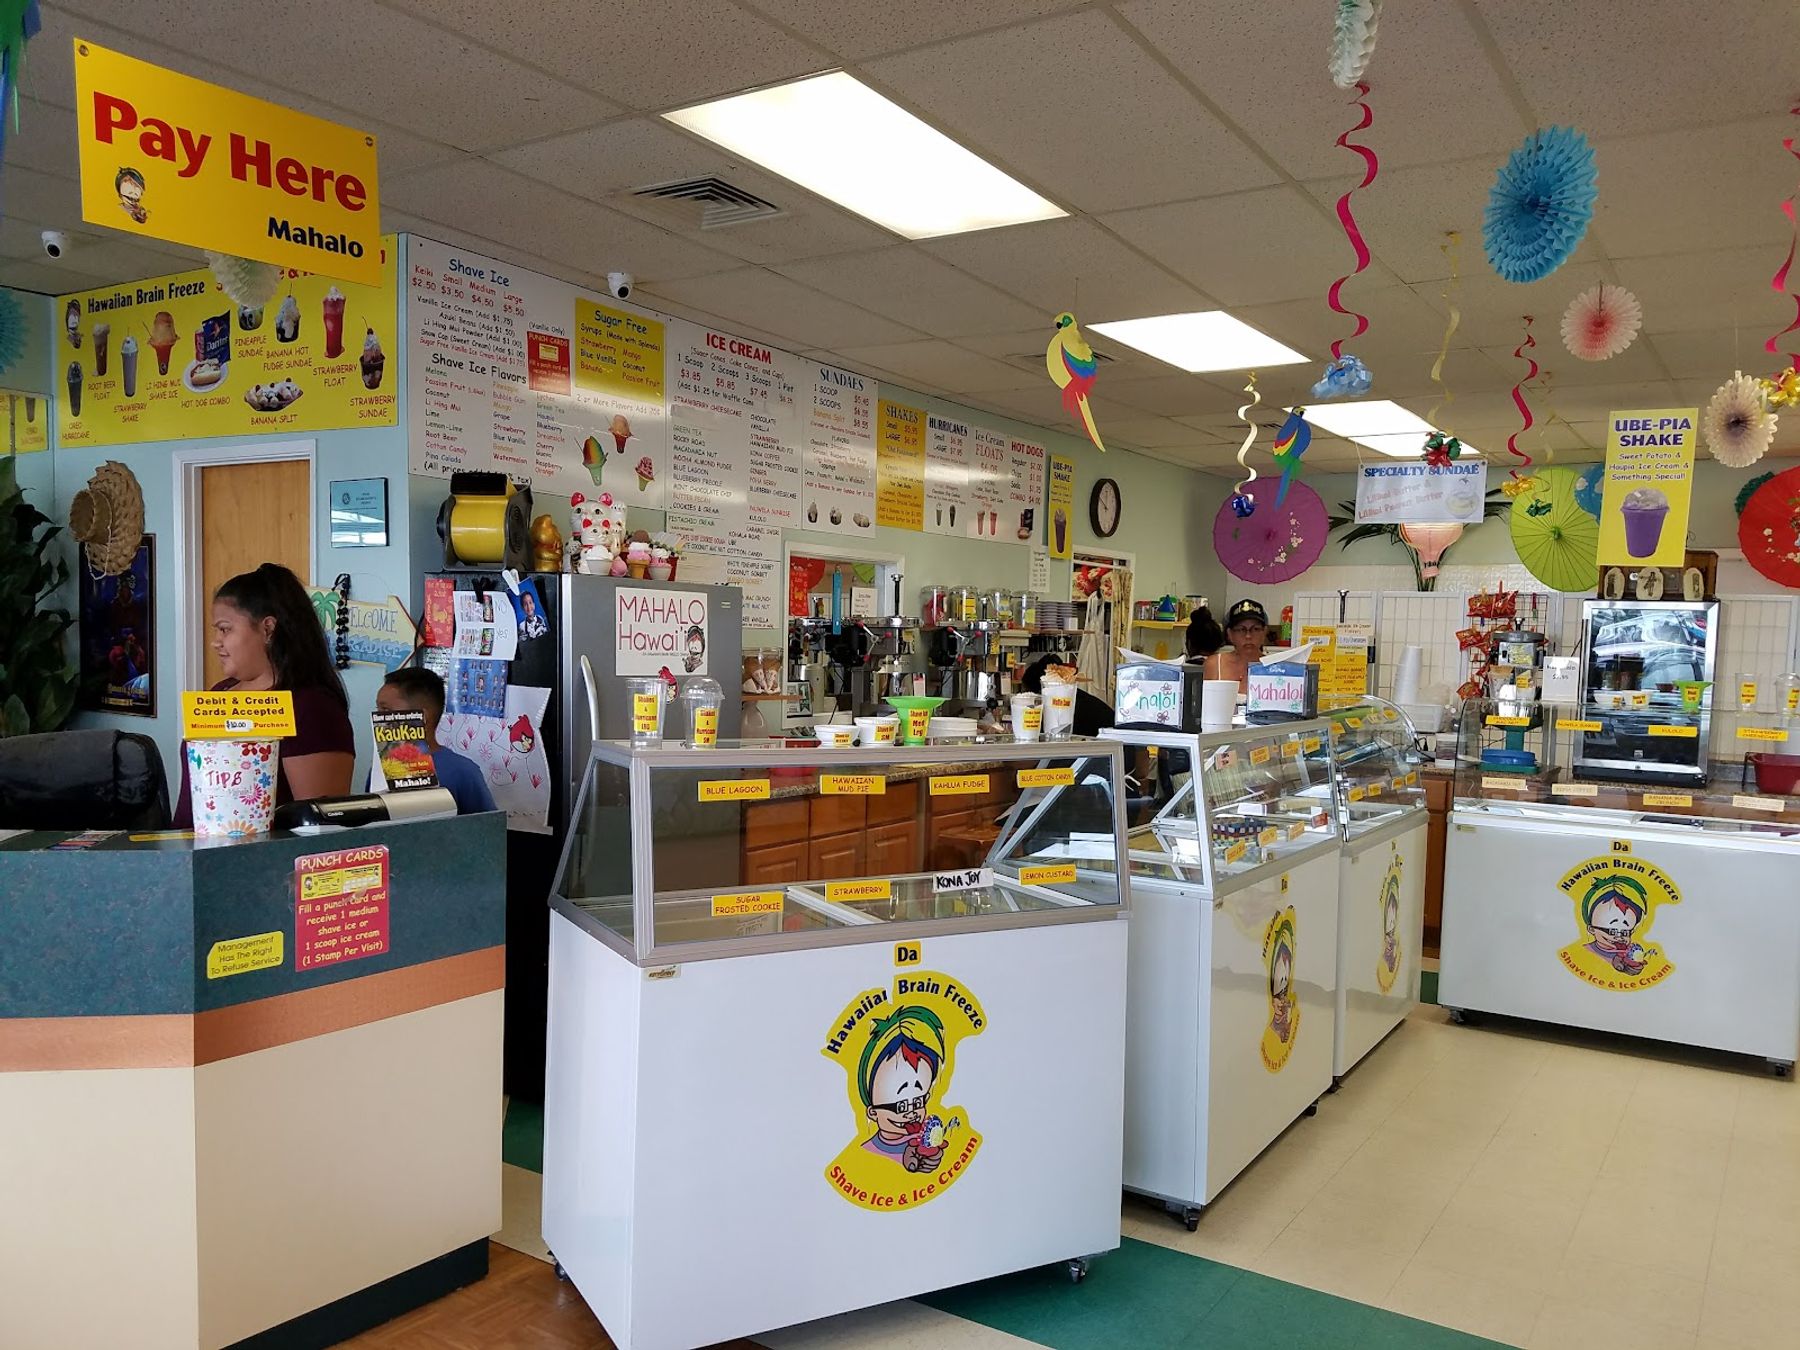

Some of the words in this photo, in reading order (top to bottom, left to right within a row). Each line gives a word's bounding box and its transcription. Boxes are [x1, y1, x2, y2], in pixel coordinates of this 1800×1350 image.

[93, 91, 212, 178] Pay
[230, 132, 367, 212] Here
[267, 217, 364, 258] Mahalo
[449, 259, 485, 279] Shave
[490, 270, 510, 287] Ice
[415, 264, 433, 277] Keiki
[443, 274, 463, 286] Small
[469, 281, 496, 296] Medium
[503, 291, 523, 304] Large
[87, 290, 133, 313] Hawaiian
[136, 286, 165, 304] Brain
[167, 280, 205, 299] Freeze
[411, 277, 437, 291] $2.50
[441, 285, 465, 299] $3.50
[472, 294, 494, 308] $4.50
[503, 304, 525, 317] $5.50
[595, 310, 622, 328] Sugar
[626, 319, 647, 334] Free
[266, 349, 292, 359] BANANA
[295, 347, 309, 356] HOT
[706, 332, 726, 351] ICE
[729, 340, 772, 364] CREAM
[263, 361, 285, 371] FUDGE
[286, 358, 313, 369] SUNDAE
[313, 364, 358, 376] STRAWBERRY
[432, 353, 464, 370] Shave
[469, 361, 487, 375] Ice
[491, 366, 527, 385] Flavors
[678, 353, 681, 361] 1
[685, 356, 704, 369] Scoop
[711, 363, 716, 371] 2
[718, 365, 739, 378] Scoops
[746, 372, 750, 380] 3
[752, 374, 771, 387] Scoops
[324, 377, 346, 388] FLOAT
[680, 369, 701, 382] $3.85
[820, 367, 864, 392] SUNDAES
[181, 399, 194, 408] HOT
[196, 398, 208, 407] DOG
[209, 396, 231, 406] COMBO
[350, 395, 396, 407] STRAWBERRY
[251, 414, 277, 425] BANANA
[279, 414, 298, 424] SPLIT
[359, 408, 387, 419] SUNDAE
[886, 405, 918, 424] SHAKES
[493, 423, 526, 436] Strawberry
[929, 417, 968, 437] HURRICANES
[1615, 418, 1692, 432] UBE-PIA
[1620, 434, 1683, 447] SHAKE
[975, 444, 1004, 461] FLOATS
[1011, 441, 1025, 453] HOT
[1026, 445, 1044, 458] DOGS
[493, 453, 528, 465] Watermelon
[1655, 462, 1680, 470] Cream
[1364, 466, 1426, 477] SPECIALTY
[1612, 473, 1652, 481] Something
[619, 594, 705, 625] MAHALO
[348, 606, 398, 634] ELCOME
[197, 697, 226, 705] Debit
[232, 697, 239, 705] &
[245, 696, 279, 705] Credit
[194, 708, 226, 716] Cards
[232, 707, 285, 716] Accepted
[375, 724, 425, 742] KauKau
[395, 777, 431, 788] Mahalo!
[832, 777, 874, 785] HAWAIIAN
[838, 785, 853, 793] MUD
[963, 780, 985, 788] FUDGE
[706, 787, 726, 795] BLUE
[729, 785, 763, 794] LAGOON
[1613, 842, 1629, 851] Da
[301, 856, 342, 871] PUNCH
[346, 849, 384, 862] CARDS
[936, 874, 963, 889] KONA
[965, 870, 981, 886] JOY
[1023, 871, 1044, 879] LEMON
[1046, 870, 1073, 878] CUSTARD
[1561, 860, 1609, 891] Hawaiian
[1613, 859, 1645, 873] Brain
[1648, 869, 1679, 902] Freeze
[736, 895, 761, 903] SUGAR
[833, 886, 883, 896] STRAWBERRY
[298, 905, 312, 915] Fill
[323, 898, 347, 912] punch
[349, 894, 369, 905] card
[372, 891, 386, 901] and
[715, 904, 751, 915] FROSTED
[753, 902, 781, 911] COOKIE
[306, 914, 337, 926] receive
[341, 910, 345, 919] 1
[349, 905, 379, 917] medium
[318, 925, 342, 936] shave
[344, 921, 357, 931] ice
[359, 920, 369, 928] or
[218, 936, 274, 953] Management
[305, 942, 310, 951] 1
[314, 939, 338, 950] scoop
[340, 934, 353, 944] ice
[355, 930, 380, 941] cream
[219, 953, 235, 963] Has
[237, 951, 250, 960] The
[252, 946, 273, 959] Right
[302, 955, 312, 967] (1
[315, 950, 342, 965] Stamp
[344, 946, 359, 956] Per
[361, 940, 383, 952] Visit)
[897, 946, 918, 963] Da
[211, 967, 220, 975] To
[223, 961, 249, 973] Refuse
[251, 955, 280, 968] Service
[1560, 951, 1586, 978] Shave
[1588, 974, 1605, 986] Ice
[1607, 981, 1615, 989] &
[1619, 981, 1636, 989] Ice
[1639, 963, 1672, 986] Cream
[898, 977, 941, 995] Brain
[944, 984, 983, 1029] Freeze
[829, 1165, 868, 1202] Shave
[870, 1192, 894, 1207] Ice
[898, 1193, 908, 1206] &
[912, 1183, 936, 1203] Ice
[938, 1135, 979, 1187] Cream
